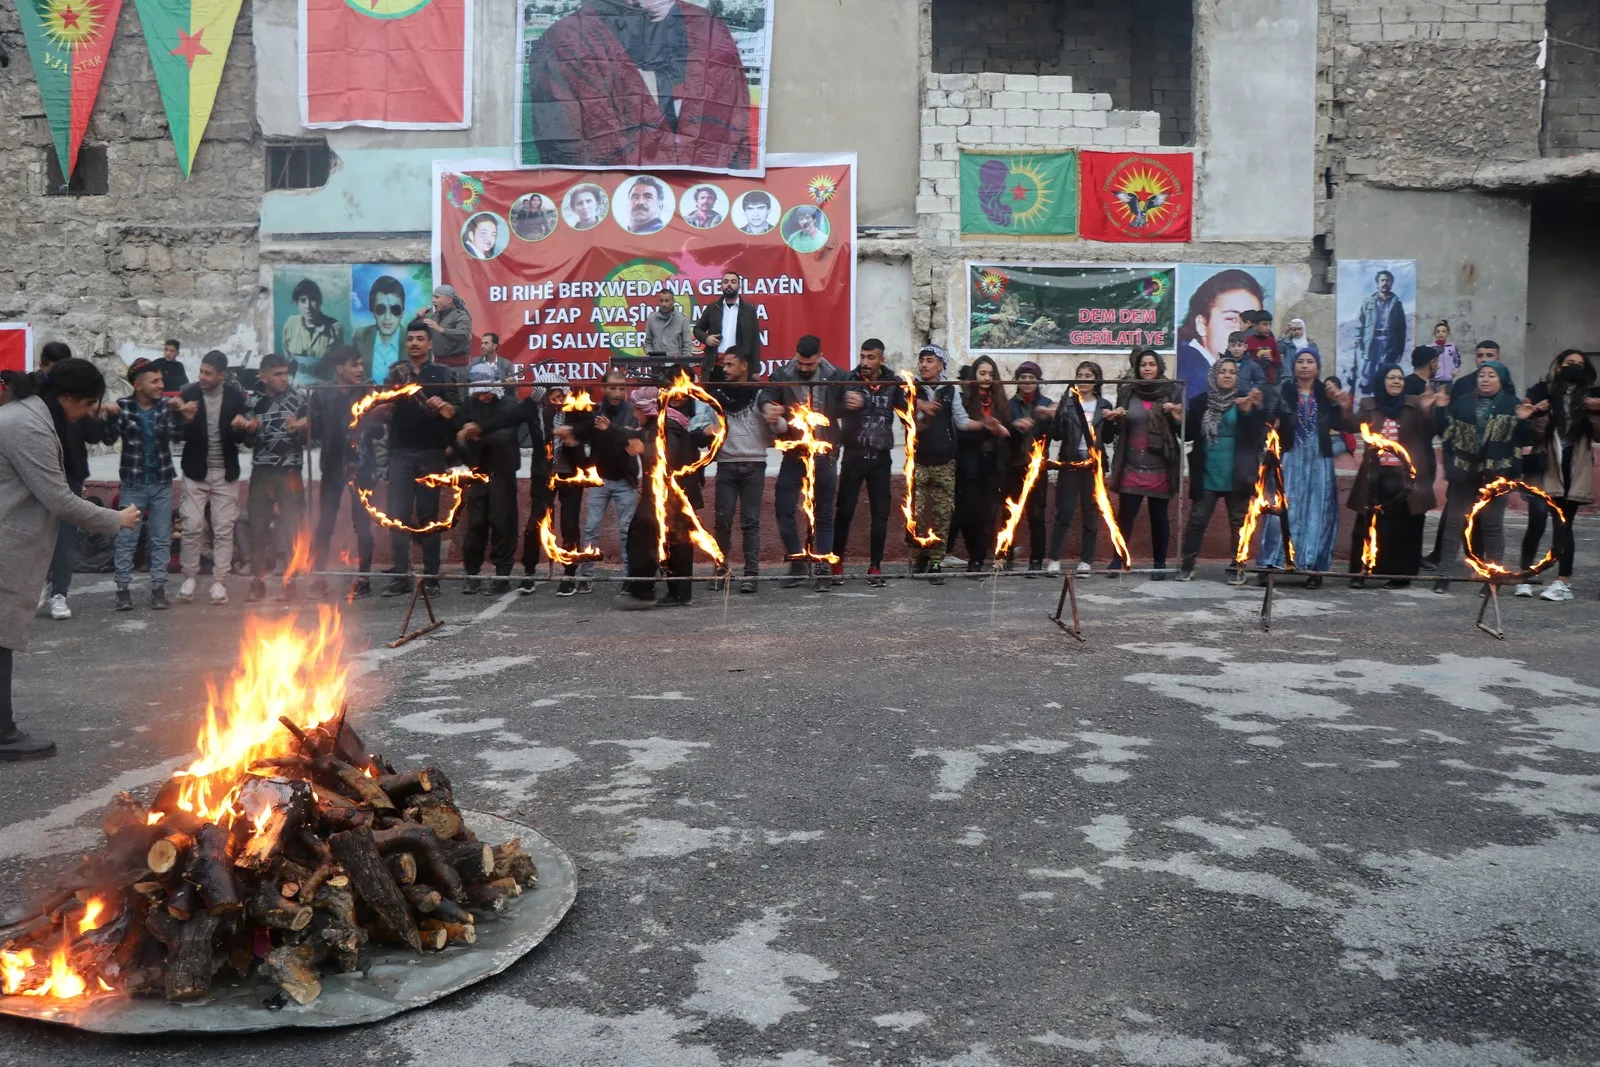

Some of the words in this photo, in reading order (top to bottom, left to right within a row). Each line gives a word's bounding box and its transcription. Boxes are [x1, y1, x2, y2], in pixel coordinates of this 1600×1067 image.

[43, 52, 68, 74] YJA
[73, 54, 103, 73] STAR
[489, 285, 508, 302] BI
[512, 280, 554, 301] RIHÊ
[558, 279, 694, 299] BERXWEDANA
[698, 274, 804, 296] GEÎLAYÊN
[524, 309, 540, 326] LI
[544, 307, 582, 325] ZAP
[1078, 308, 1116, 323] DEM
[1118, 308, 1157, 324] DEM
[528, 333, 547, 350] DI
[551, 331, 647, 350] SALVEGER
[1069, 327, 1143, 346] GERÎLATÎ
[1144, 330, 1165, 346] YE
